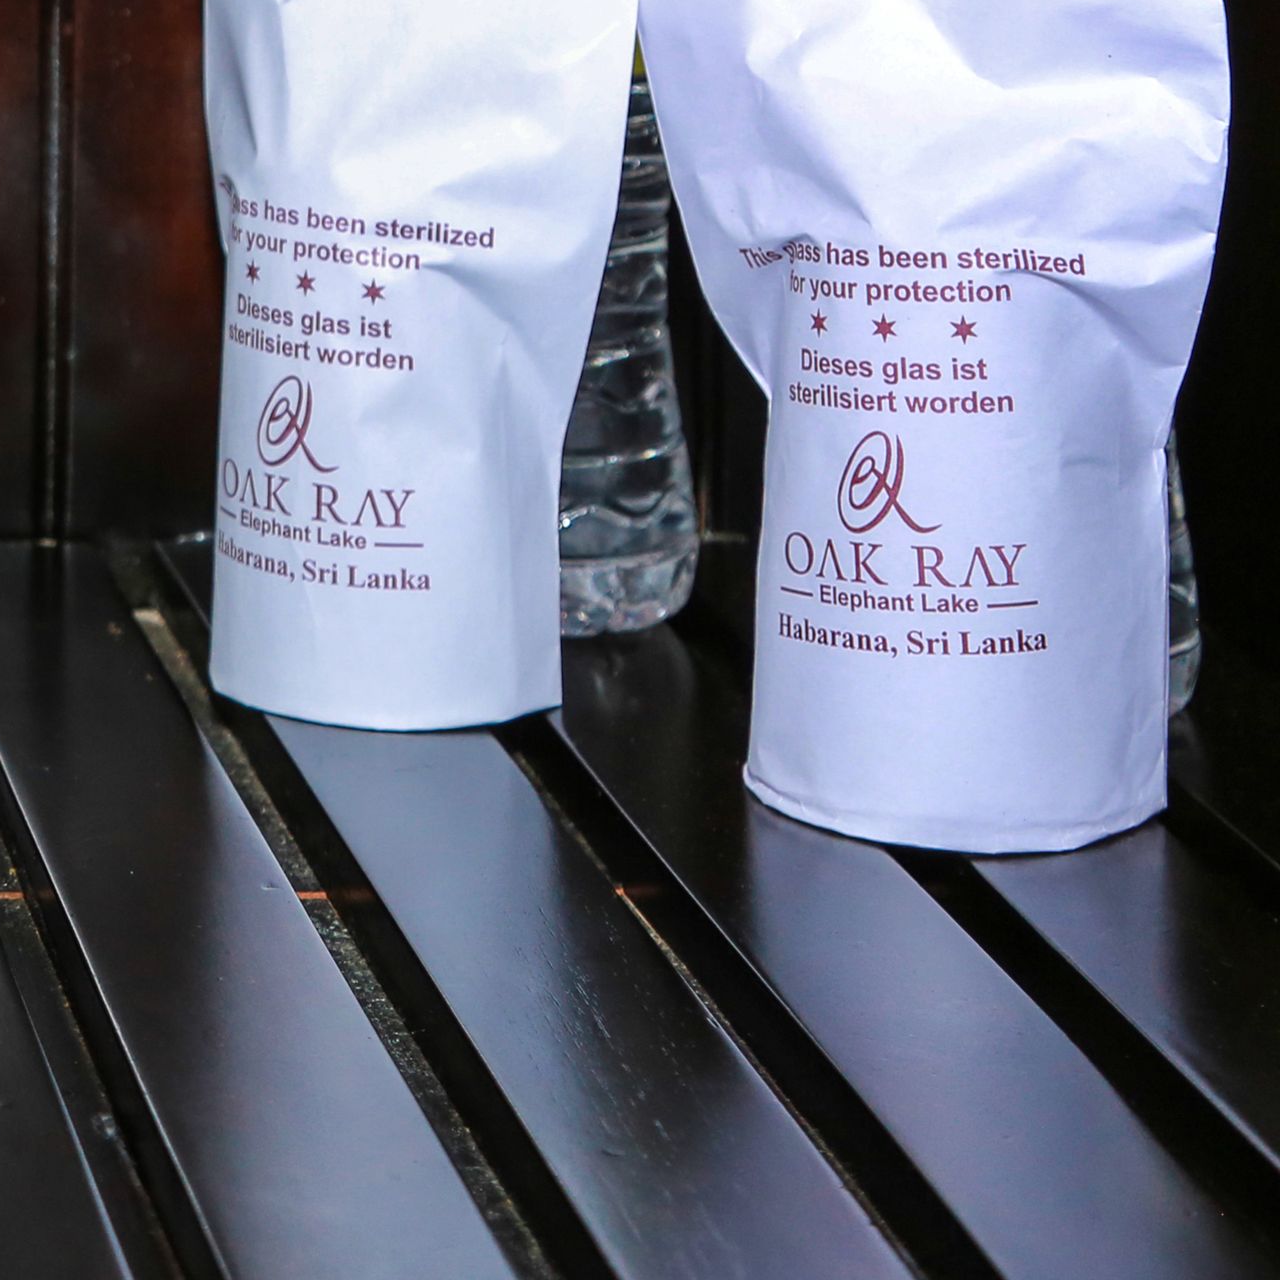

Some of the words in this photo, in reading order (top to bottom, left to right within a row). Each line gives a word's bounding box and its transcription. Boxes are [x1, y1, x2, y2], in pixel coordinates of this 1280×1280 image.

[264, 200, 300, 225] has
[307, 207, 365, 235] been
[375, 220, 495, 248] sterilized
[246, 229, 287, 254] your
[293, 237, 421, 270] protection
[739, 247, 783, 270] This
[827, 242, 869, 267] has
[879, 245, 947, 269] been
[957, 248, 1085, 276] sterilized
[809, 278, 857, 300] your
[866, 280, 1012, 305] protection
[238, 293, 293, 327] Dieses
[301, 310, 350, 335] glas
[360, 316, 392, 339] ist
[229, 323, 310, 361] sterilisiert
[317, 346, 414, 371] worden
[801, 347, 873, 378] Dieses
[882, 357, 941, 384] glas
[952, 358, 988, 380] ist
[789, 382, 897, 412] sterilisiert
[904, 391, 1014, 413] worden
[222, 458, 292, 516] OAK
[311, 481, 415, 528] RAY
[240, 510, 311, 543] Elephant
[317, 526, 367, 550] Lake
[302, 558, 338, 585] Sri
[347, 565, 431, 591] Lanka
[784, 531, 888, 585] OAK
[910, 543, 1027, 588] RAY
[819, 584, 914, 612] Elephant
[921, 593, 979, 613] Lake
[779, 612, 898, 658] Habarana,
[906, 630, 950, 655] Sri
[960, 628, 1048, 656] Lanka
